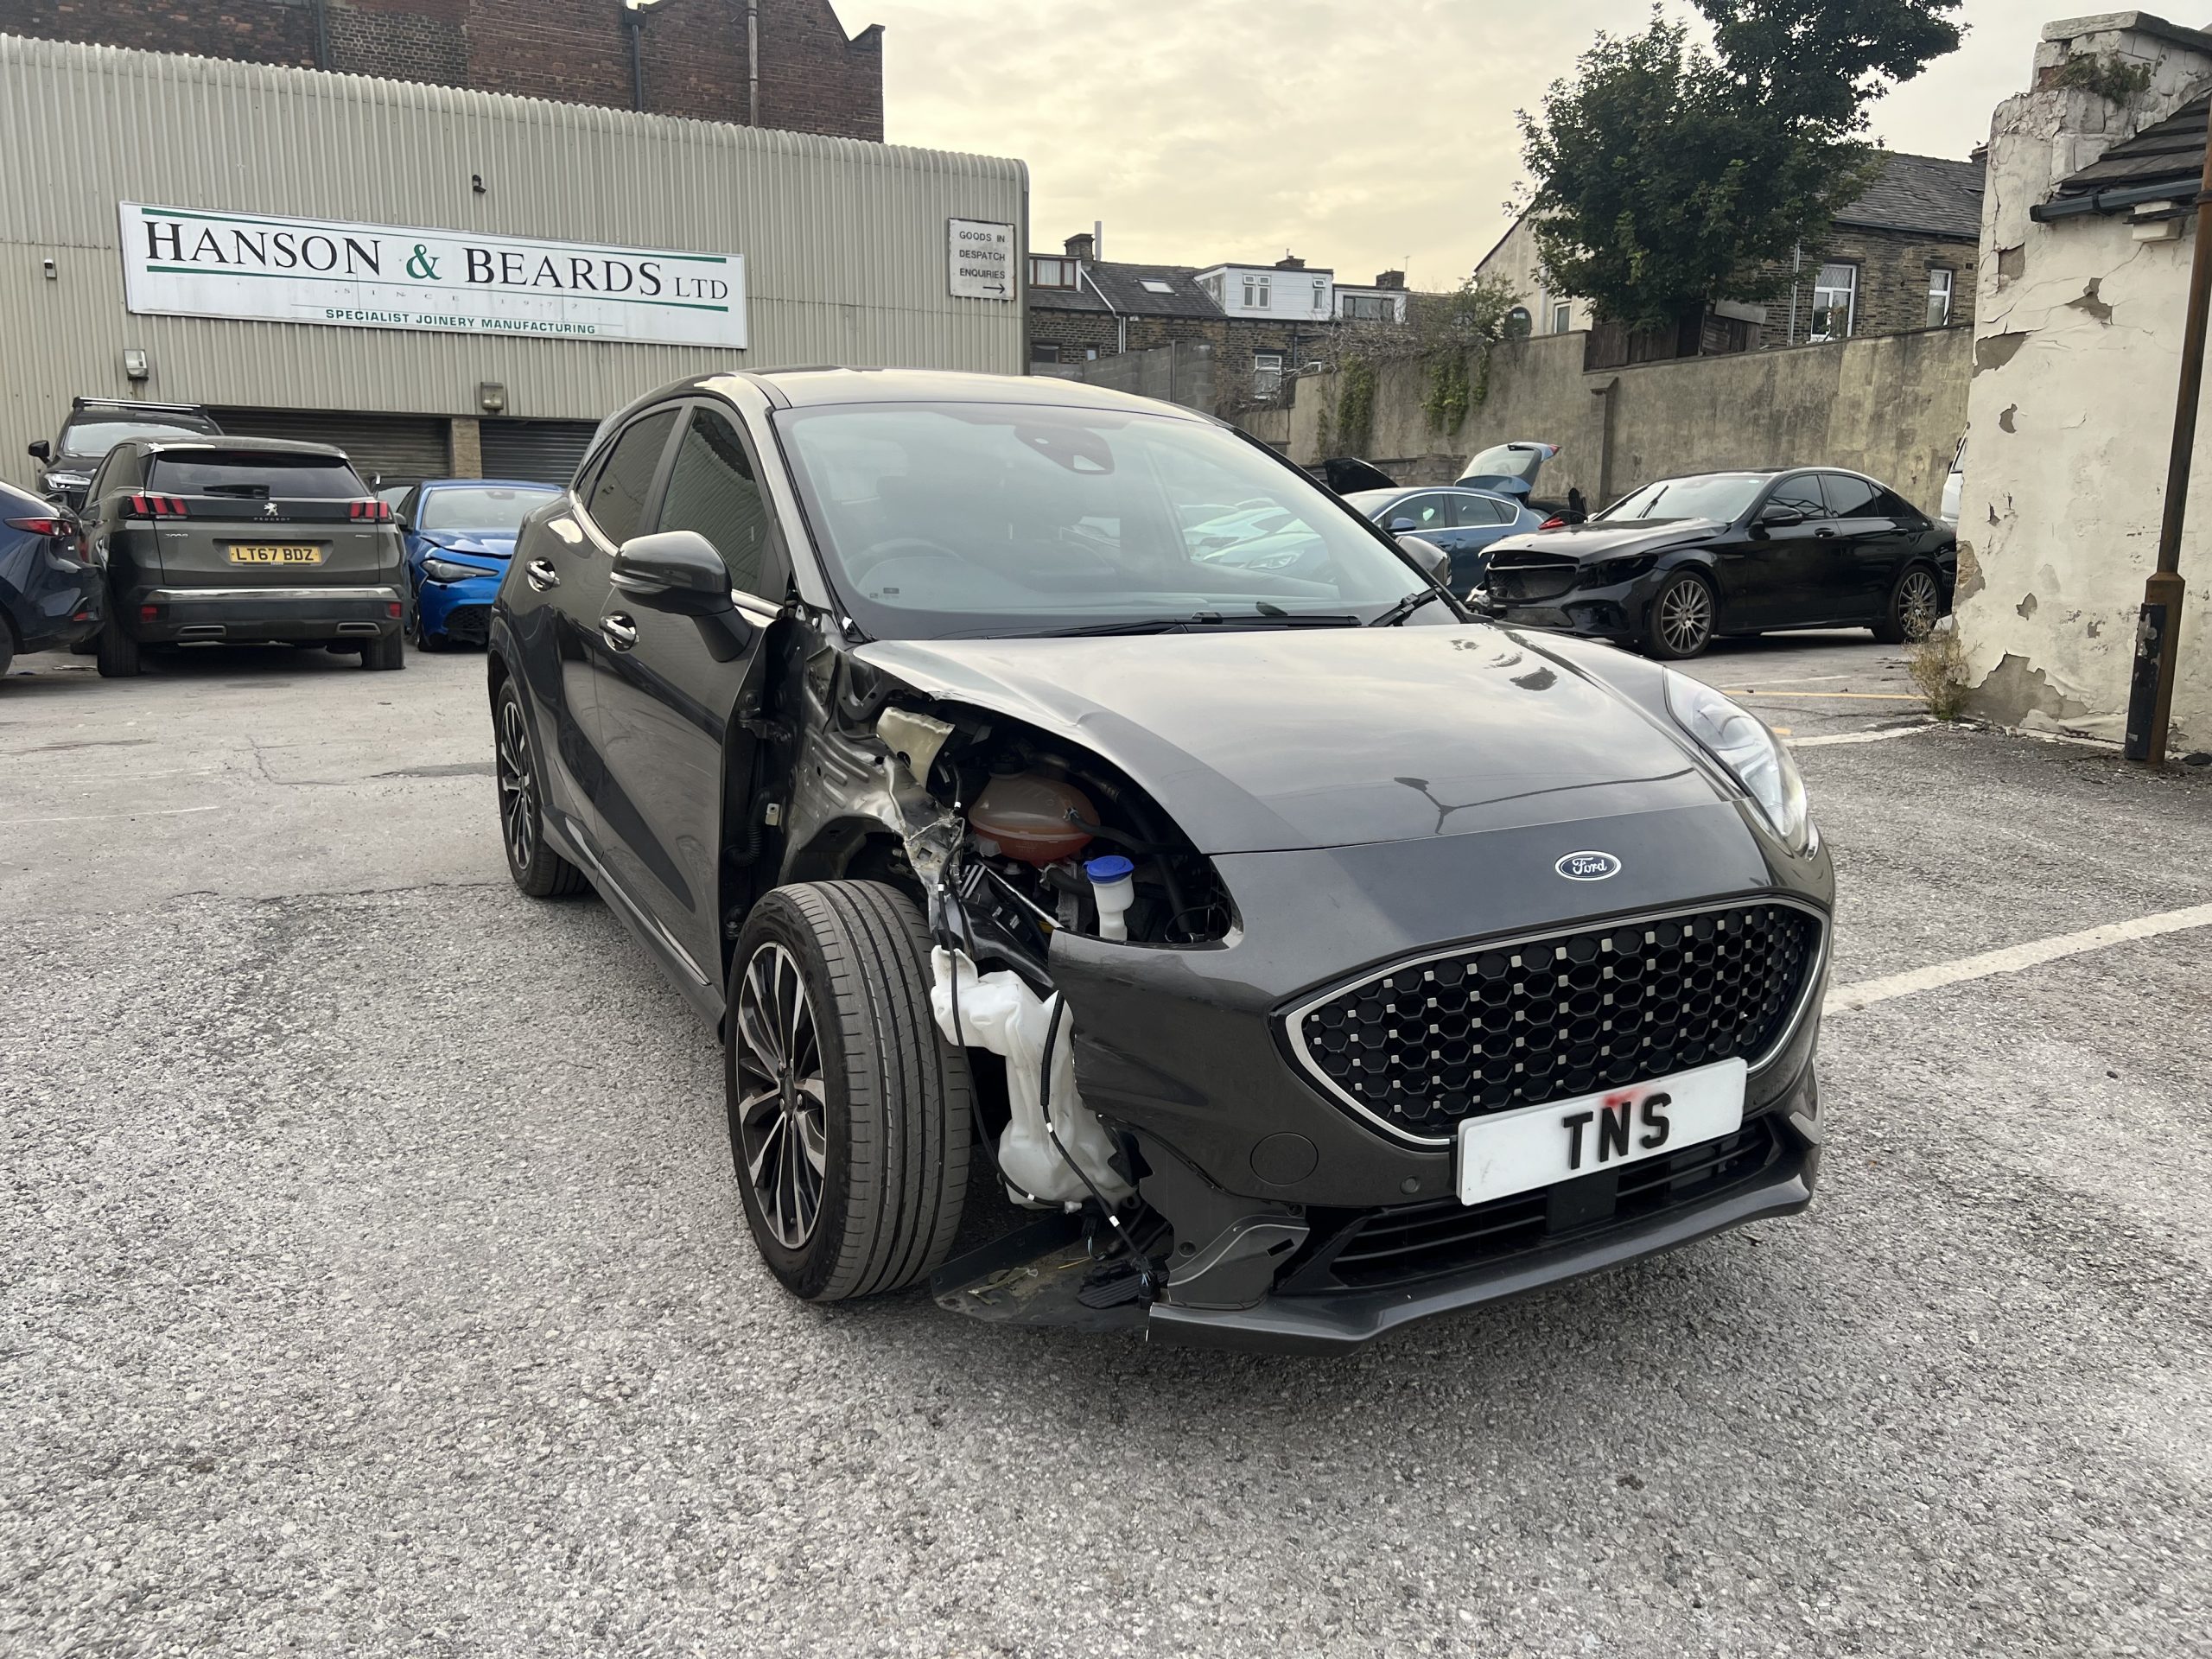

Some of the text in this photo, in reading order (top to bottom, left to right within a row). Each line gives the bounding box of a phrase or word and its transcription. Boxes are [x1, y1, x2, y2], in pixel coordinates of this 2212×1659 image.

[959, 231, 992, 241] GOODS
[144, 221, 728, 300] HANSON & BEARDS LTD
[959, 250, 1005, 261] DESPATCH
[959, 268, 1006, 279] ENQUIRIES
[344, 288, 460, 302] SINCE
[326, 308, 595, 334] SPECIALIST JOINERY MANUFACTURING
[236, 548, 314, 561] LT67 BDZ
[1572, 857, 1607, 874] Ford
[1561, 1092, 1672, 1170] TNS
